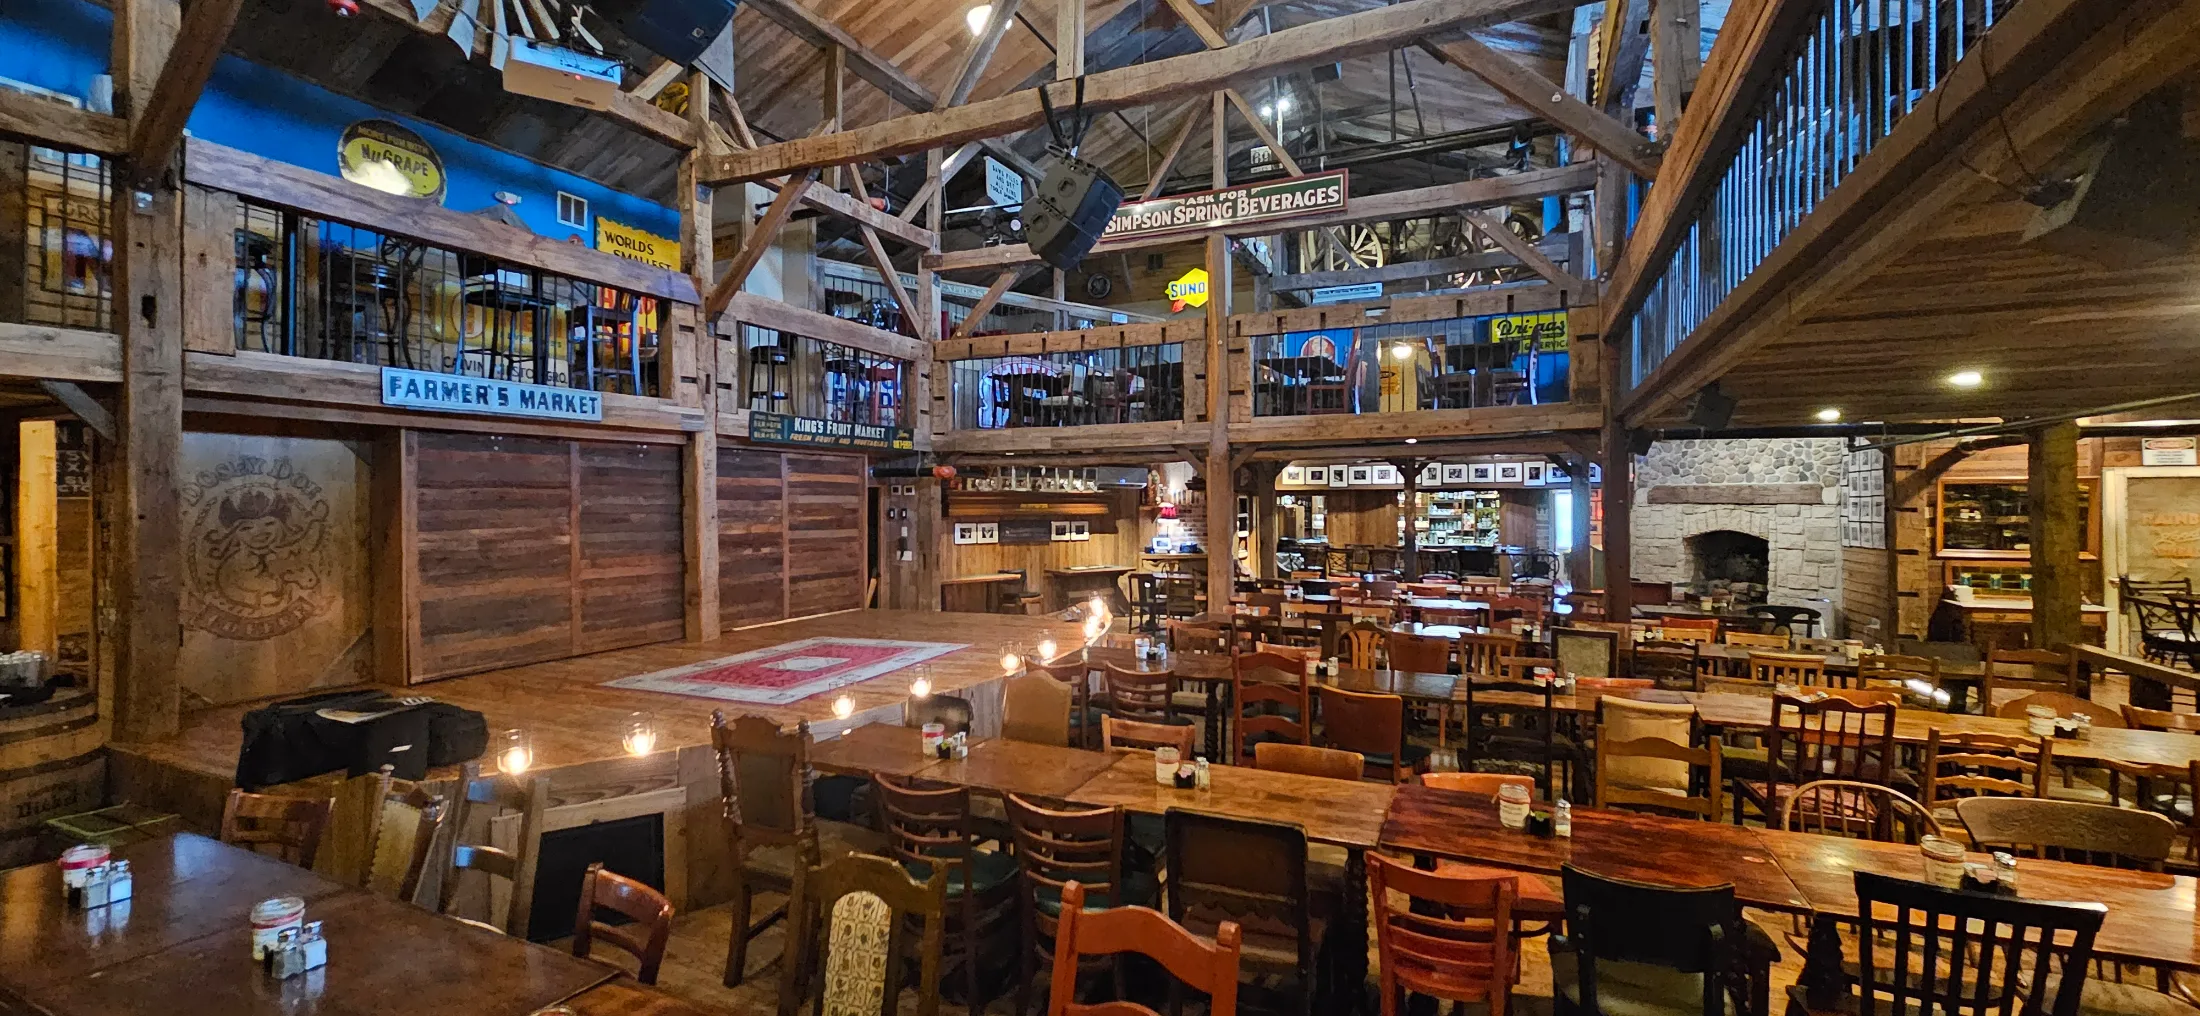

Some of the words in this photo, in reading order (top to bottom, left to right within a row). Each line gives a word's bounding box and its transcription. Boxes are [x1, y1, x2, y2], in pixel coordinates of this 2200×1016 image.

[1186, 193, 1215, 205] ASK
[1219, 189, 1247, 201] FOR
[1105, 210, 1172, 234] SIMPSON
[1173, 200, 1233, 225] SPRING
[1236, 184, 1340, 217] BEVERAGES
[1171, 282, 1206, 298] SUNO
[519, 389, 598, 415] MARKET
[794, 417, 824, 433] KING'S
[827, 420, 852, 436] FRUIT
[854, 424, 886, 439] MARKET
